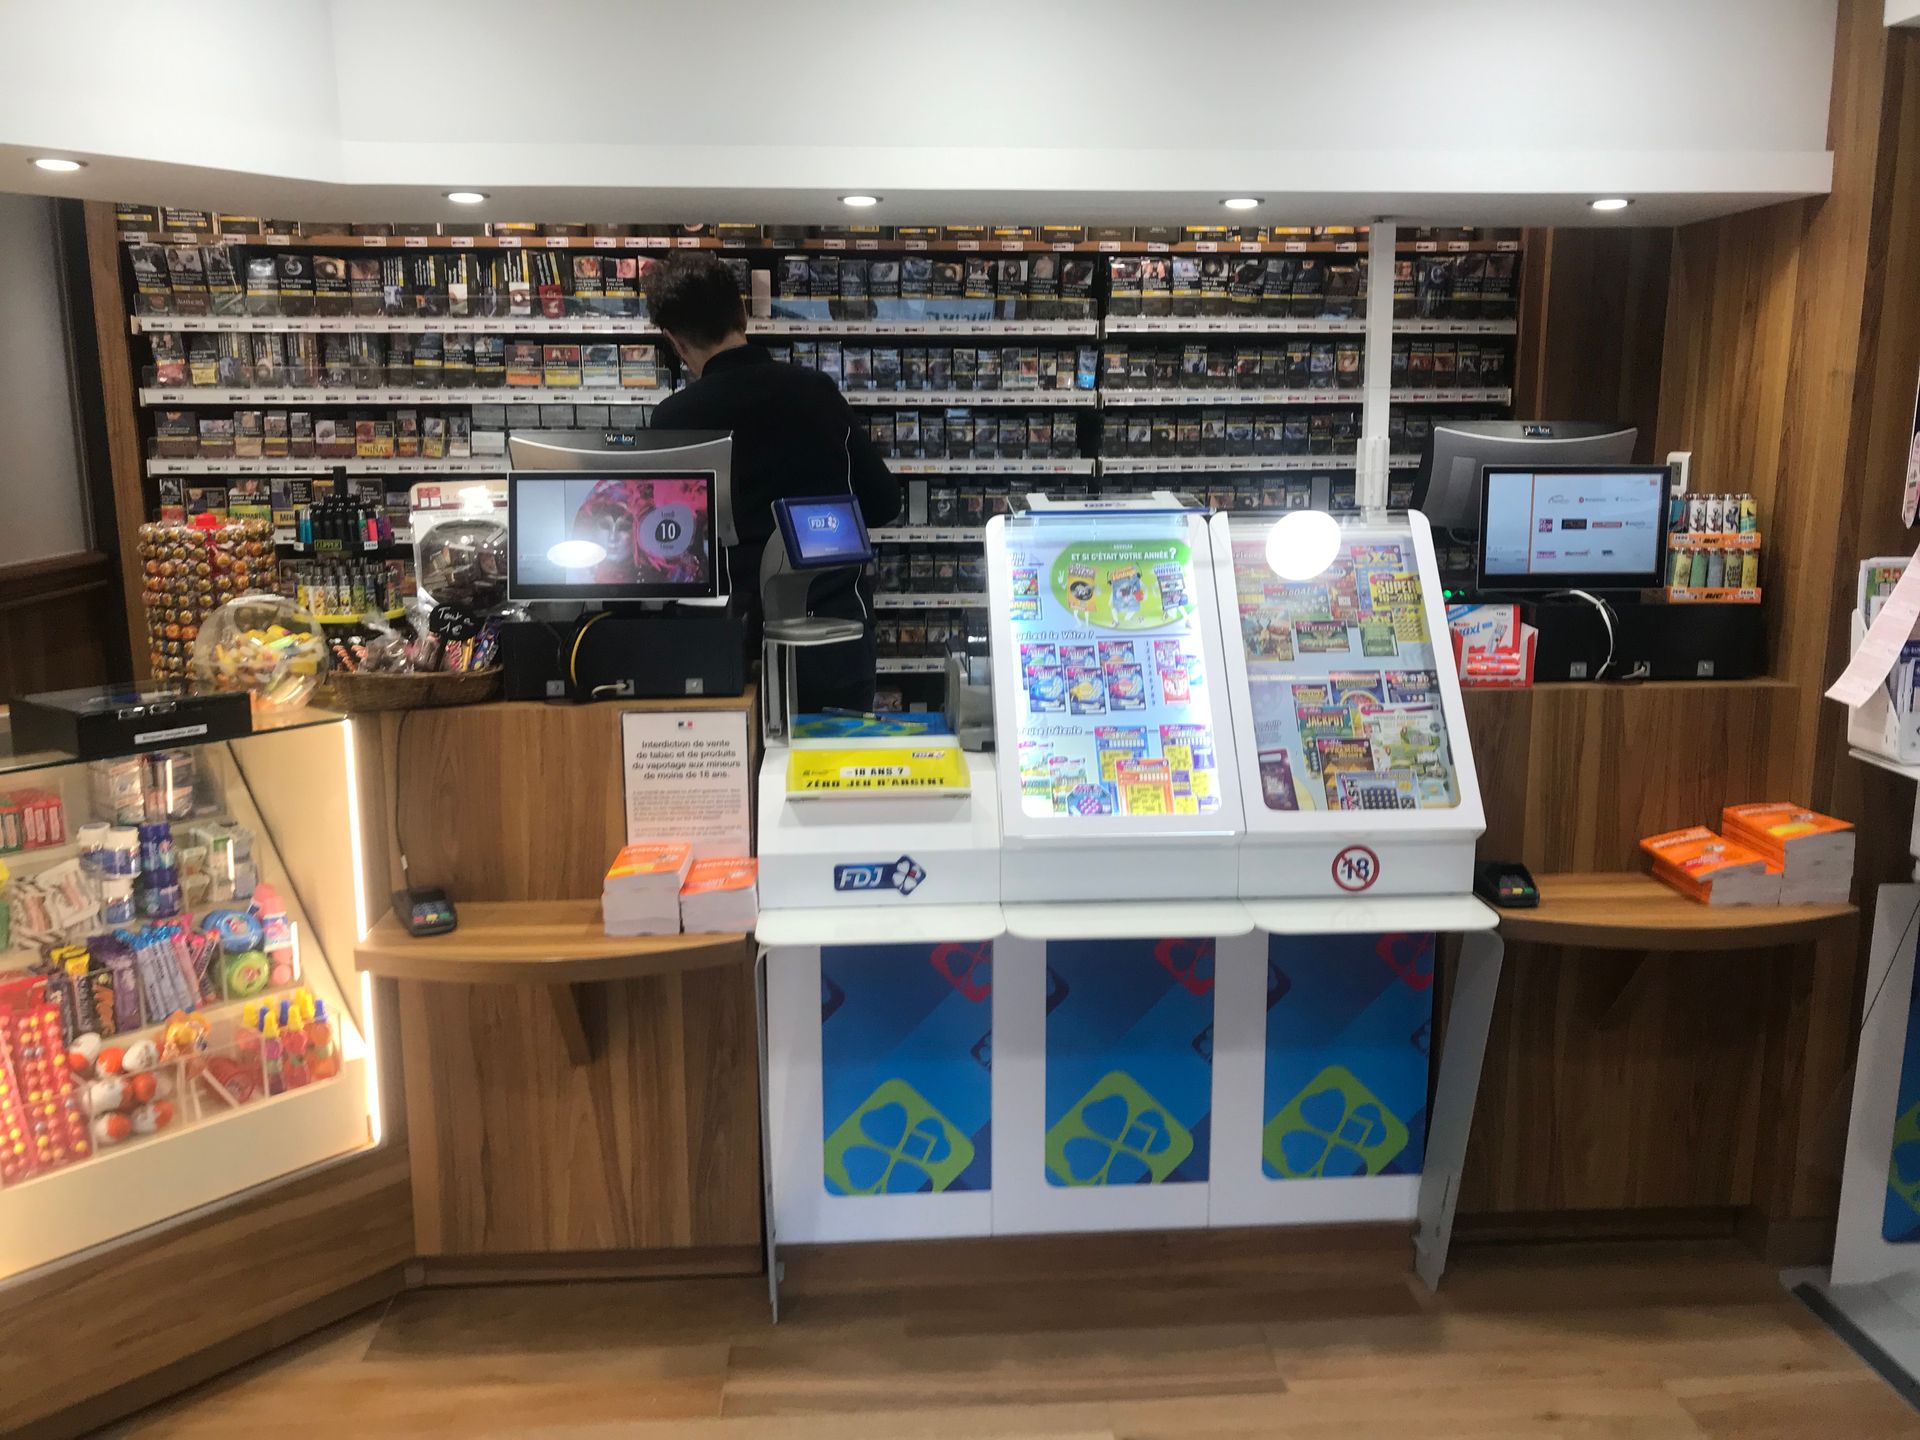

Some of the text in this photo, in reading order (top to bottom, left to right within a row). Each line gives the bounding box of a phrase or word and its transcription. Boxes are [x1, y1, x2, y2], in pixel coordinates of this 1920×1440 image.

[660, 522, 676, 541] 10
[1071, 547, 1177, 561] ET SI C'ÉTAIT VOTRE ANNÉE ?
[1376, 580, 1416, 593] SUPER
[437, 606, 462, 620] Tout
[1306, 714, 1344, 728] JACKPOT
[641, 739, 730, 749] Interdiction de vente
[636, 750, 736, 759] de tabac et de produits
[632, 760, 741, 770] du vapotage aux mineurs
[643, 772, 656, 780] de
[657, 771, 684, 779] moins
[685, 771, 697, 779] de
[699, 771, 710, 779] 18
[870, 767, 893, 776] ANS
[897, 767, 904, 776] ?
[846, 778, 871, 788] JEU
[876, 777, 945, 787] D'ARGENT
[840, 866, 884, 890] FDJ
